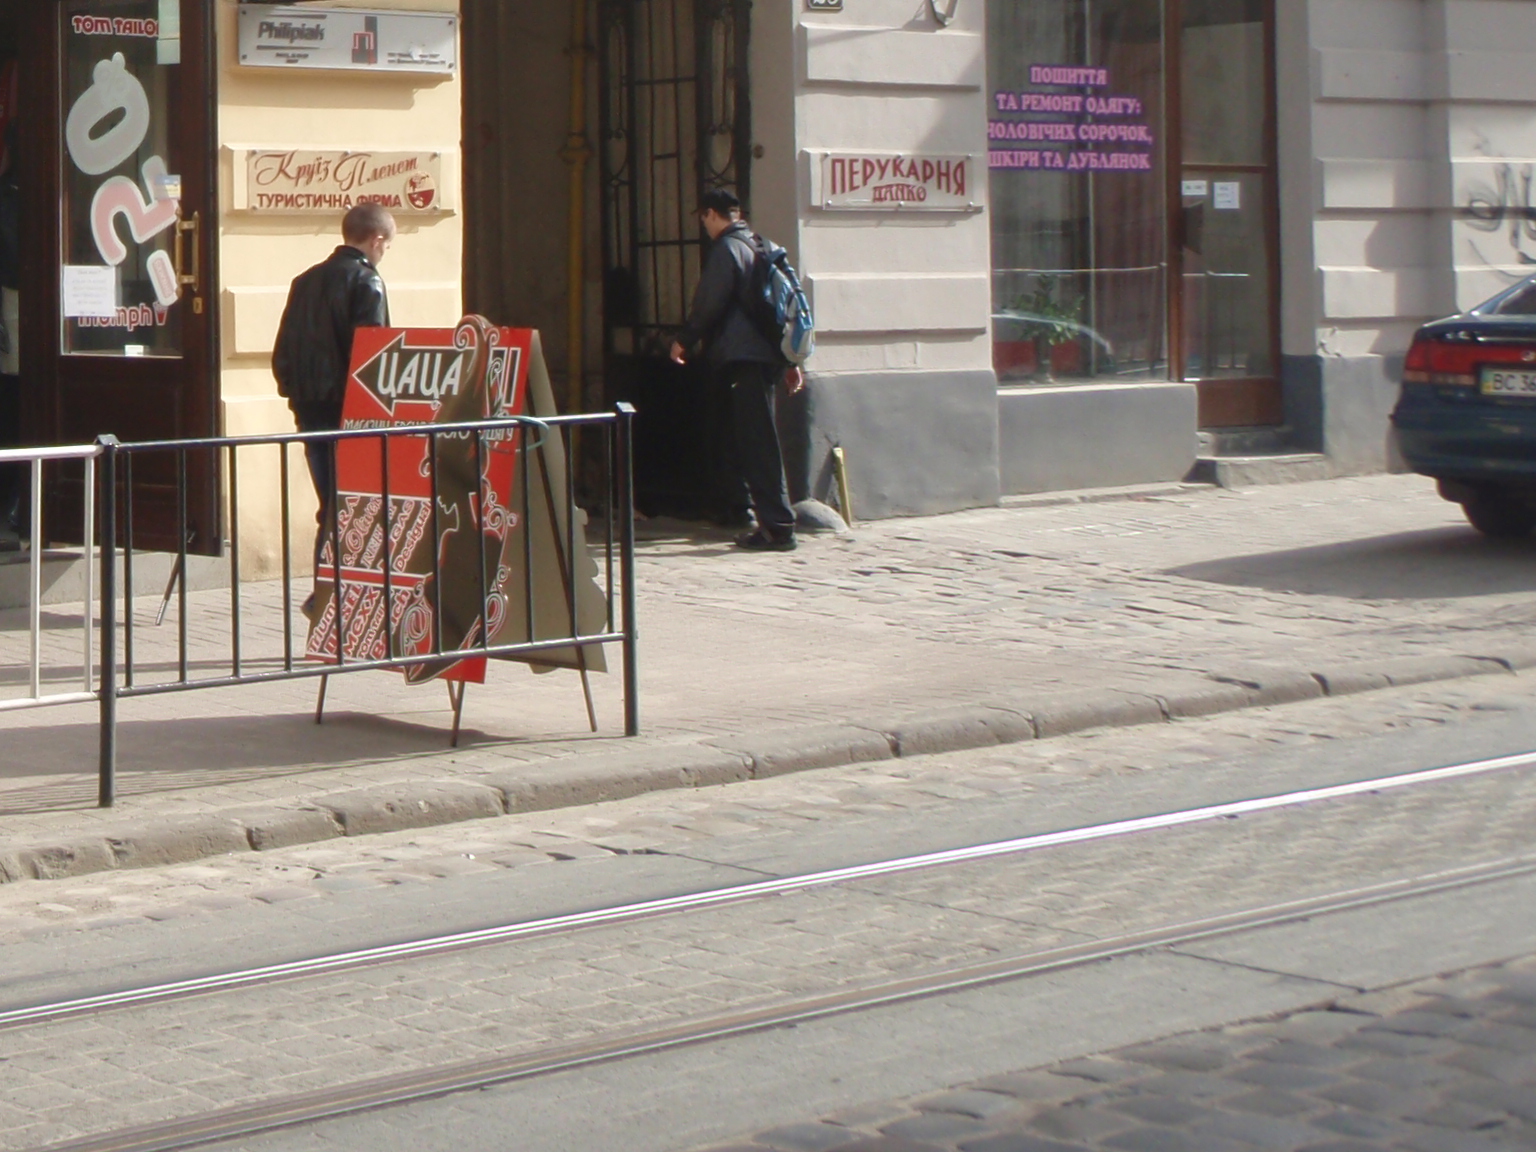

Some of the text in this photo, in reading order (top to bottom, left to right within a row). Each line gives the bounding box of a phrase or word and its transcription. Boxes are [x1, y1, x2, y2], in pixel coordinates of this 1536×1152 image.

[114, 17, 159, 38] TAILO
[1030, 66, 1107, 85] ПОШИТТЯ
[996, 94, 1141, 114] ТА РЕМОНТ ОДЯГУ:
[1078, 124, 1153, 143] СОРОЧОК,
[255, 149, 331, 187] Круїз
[1043, 152, 1064, 168] ТА
[1067, 153, 1150, 169] ДУБЛЯНОК
[831, 158, 966, 196] ПЕРУКАРНЯ
[257, 193, 353, 208] ТУРИСТИЧНА
[872, 183, 927, 203] ДАНКО
[378, 352, 464, 399] ЦАЦА
[321, 495, 361, 565] ZRA
